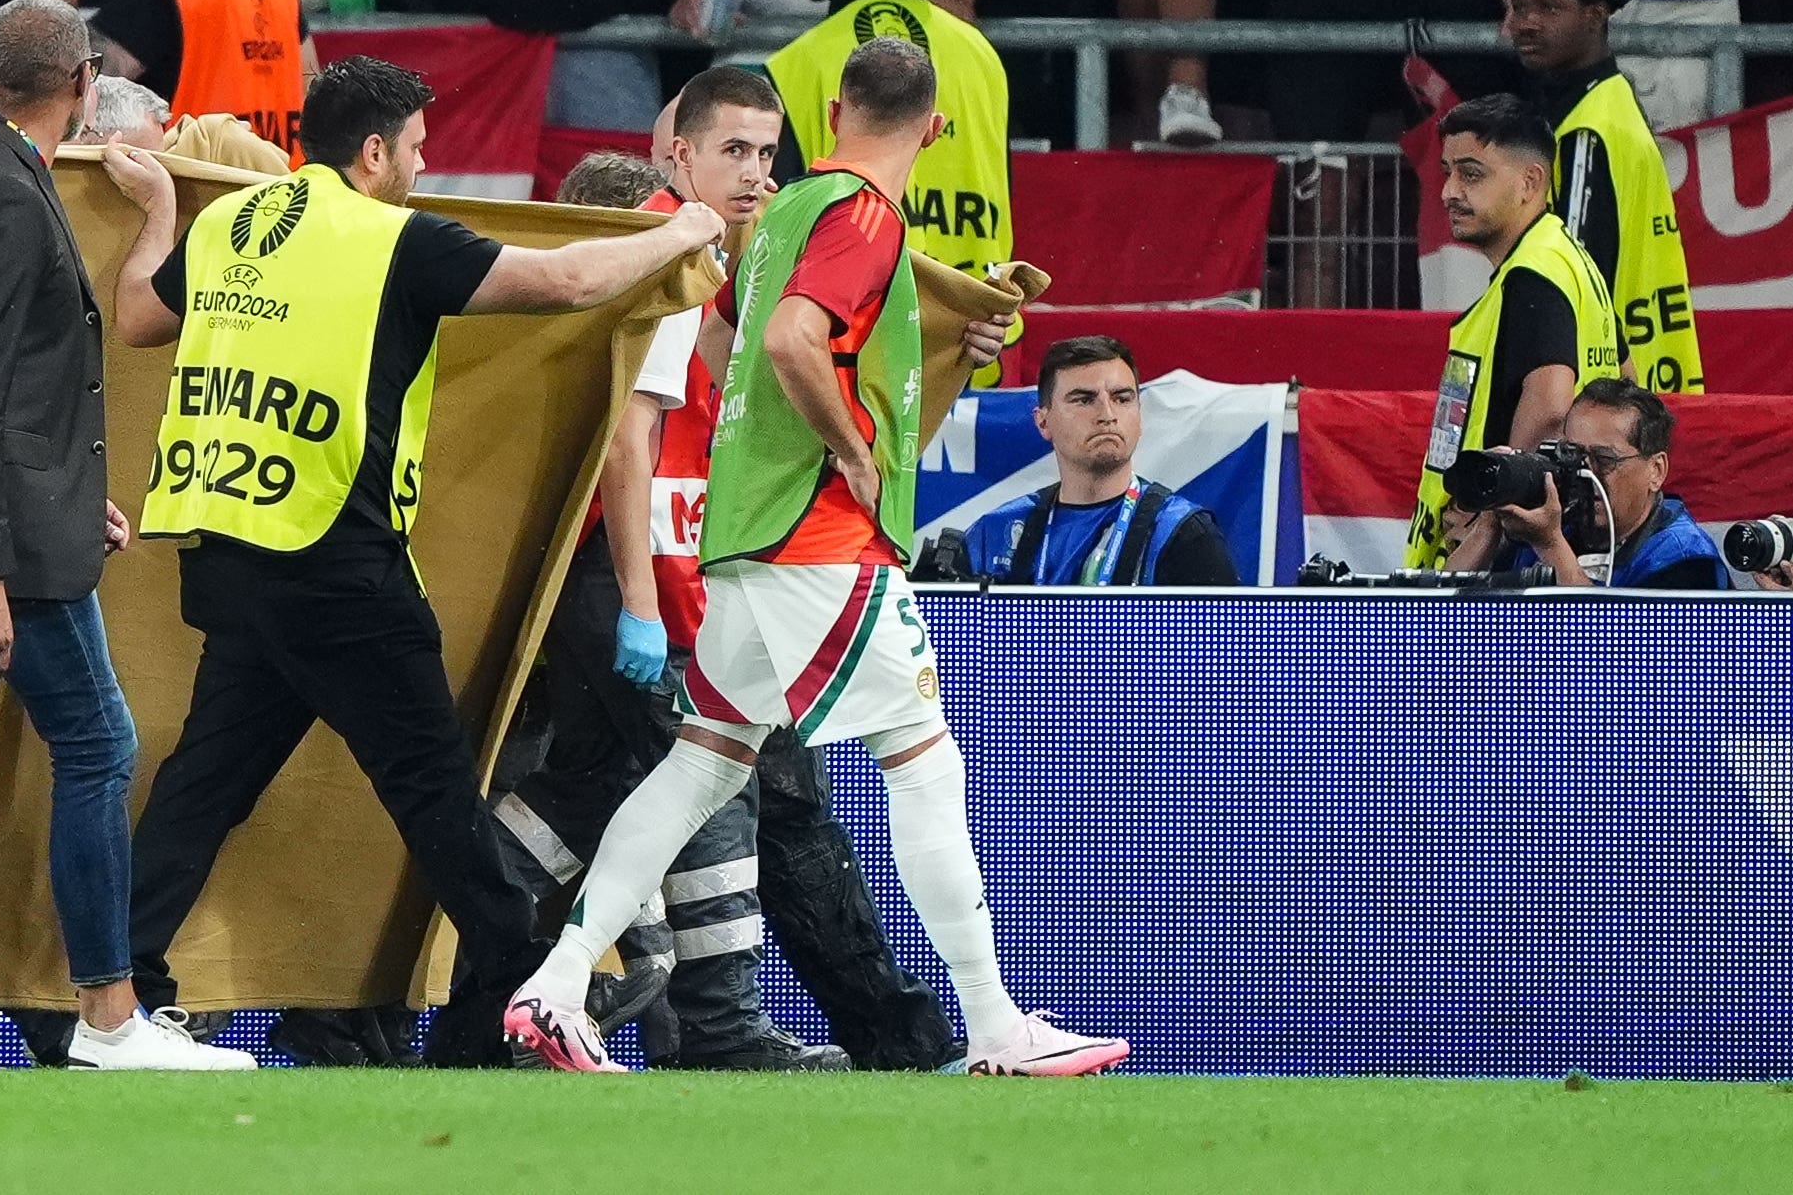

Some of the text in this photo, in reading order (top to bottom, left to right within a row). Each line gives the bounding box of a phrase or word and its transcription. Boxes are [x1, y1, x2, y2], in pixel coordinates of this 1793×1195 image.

[223, 265, 259, 288] UEFA
[192, 290, 290, 323] EURO2024
[207, 315, 256, 333] GERMANY
[171, 365, 341, 444] EWARD
